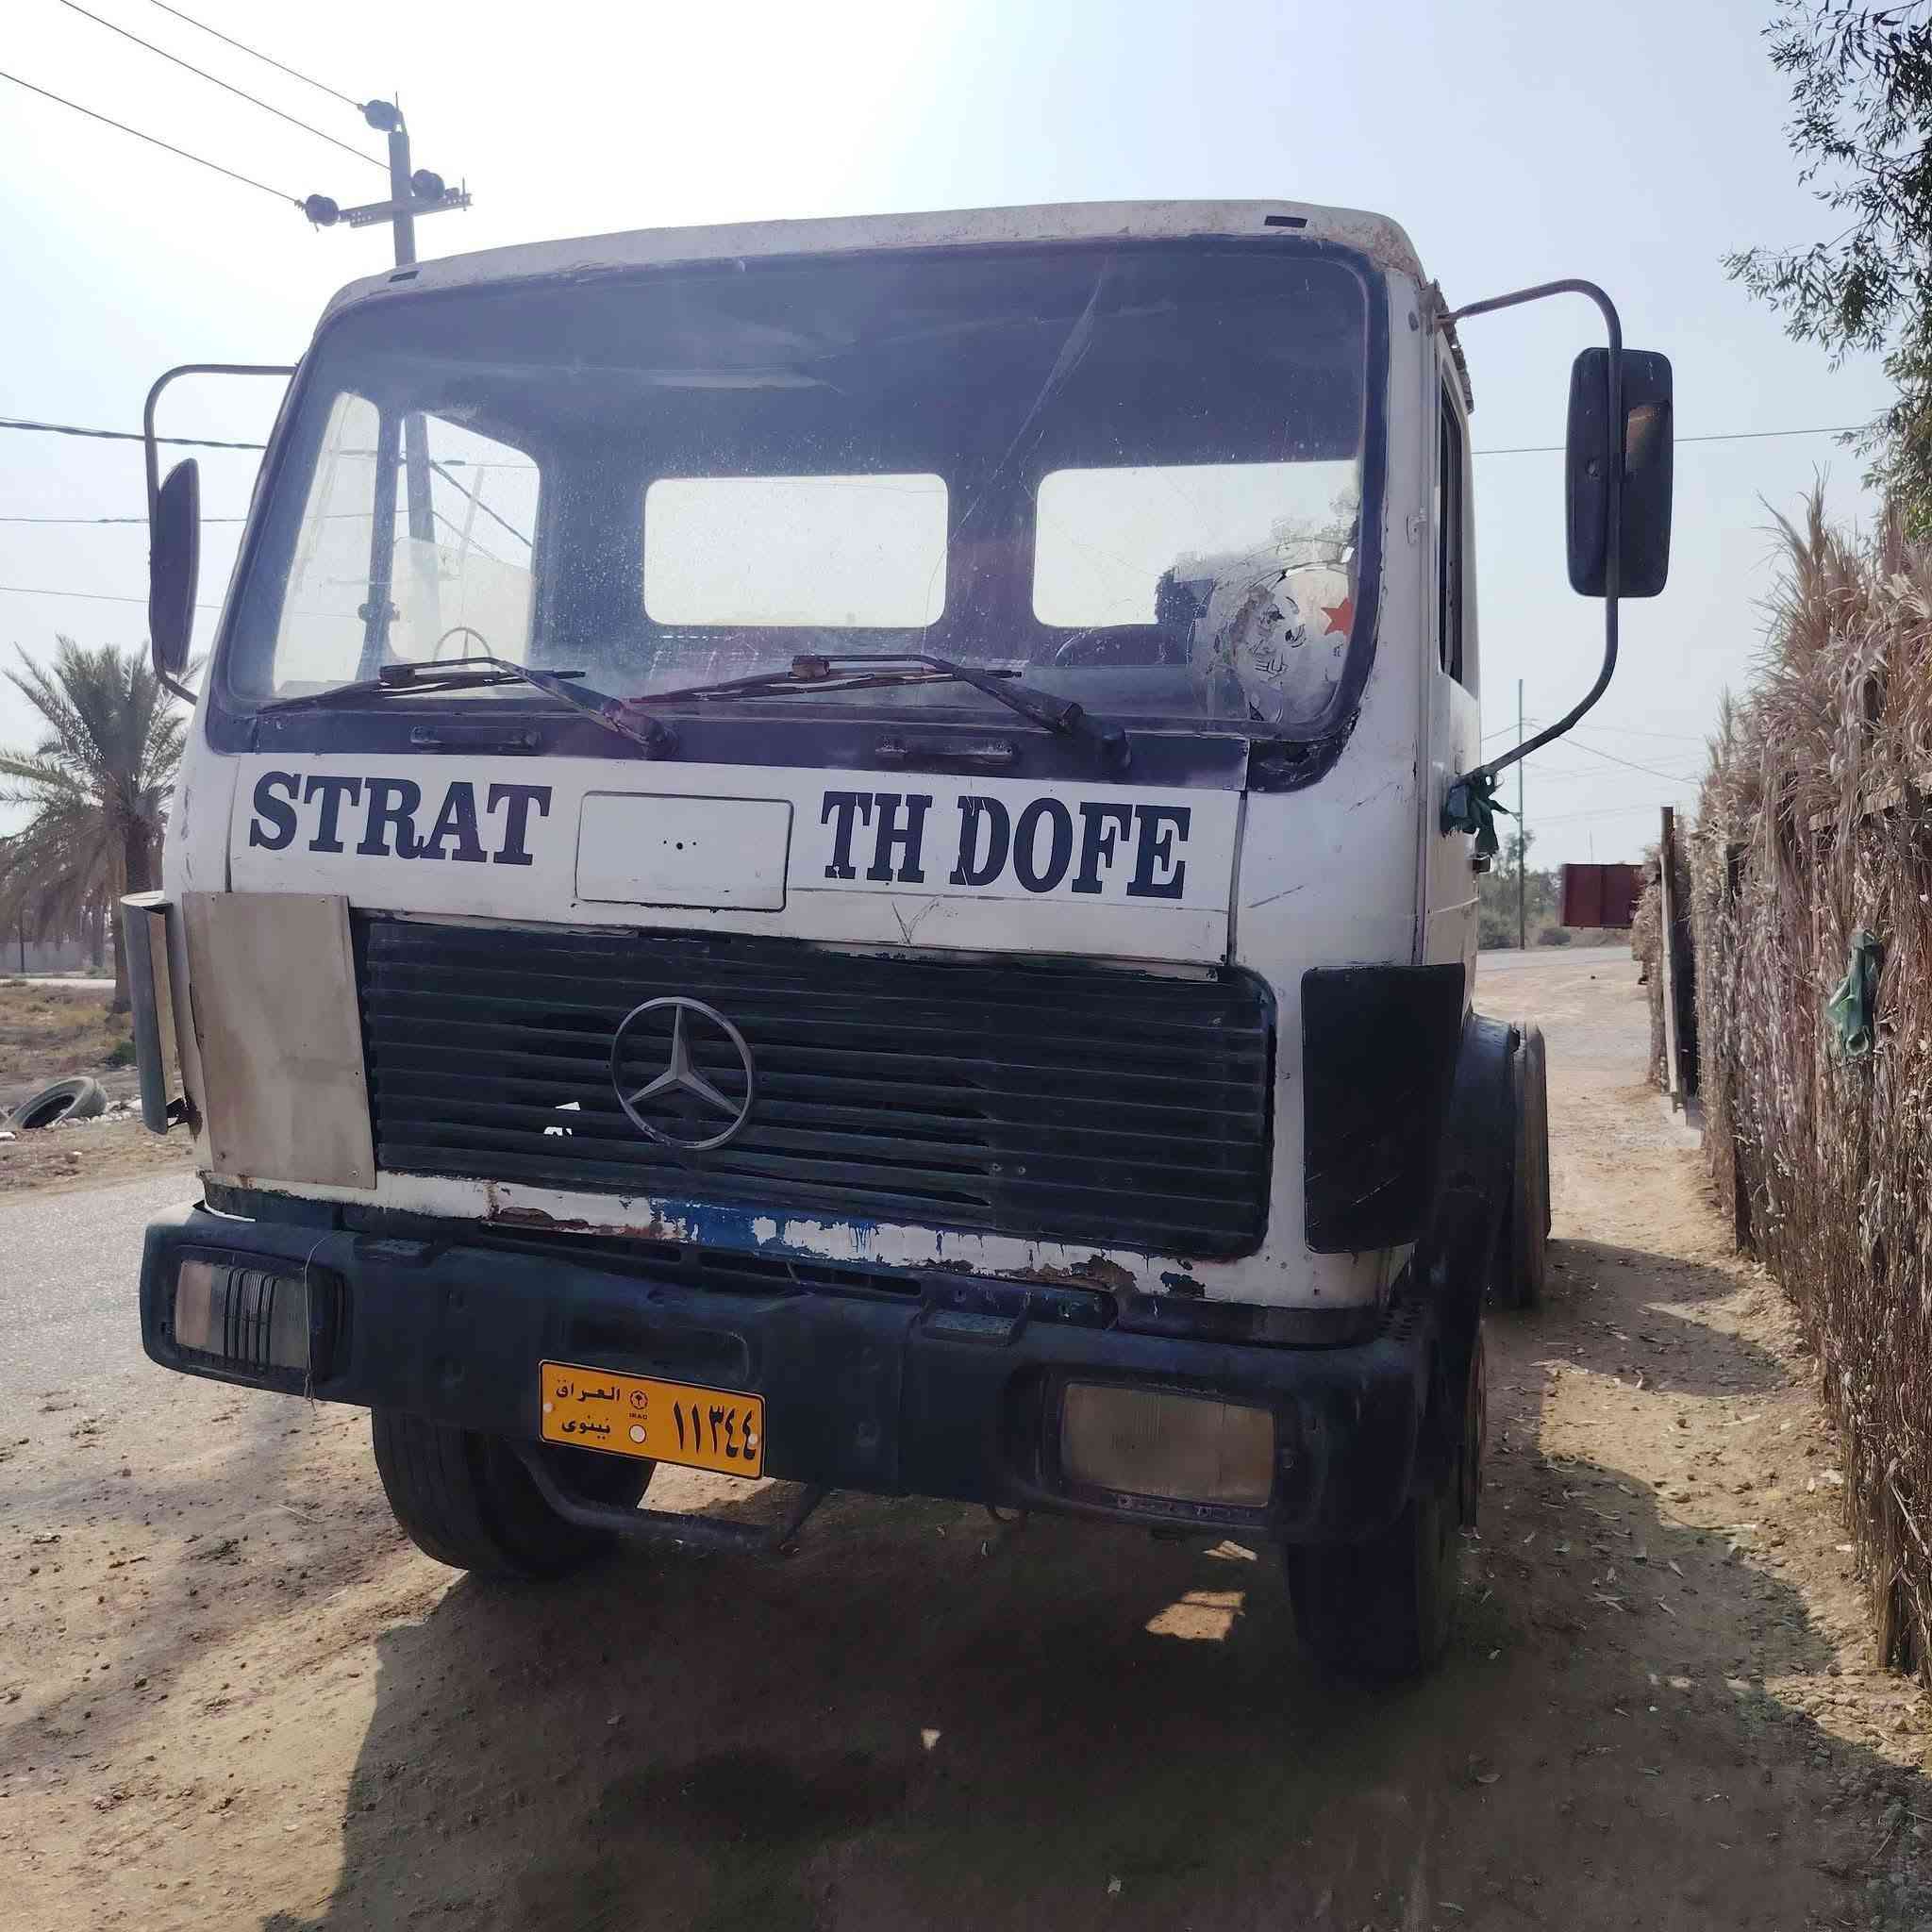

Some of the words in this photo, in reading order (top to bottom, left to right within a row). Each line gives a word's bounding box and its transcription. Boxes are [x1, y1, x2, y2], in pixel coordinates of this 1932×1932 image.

[248, 771, 553, 866] STRAT
[821, 791, 933, 883] TH
[949, 795, 1191, 899] DOFE
[556, 1379, 621, 1402] العراق
[673, 1401, 757, 1459] ١١٣٤٤
